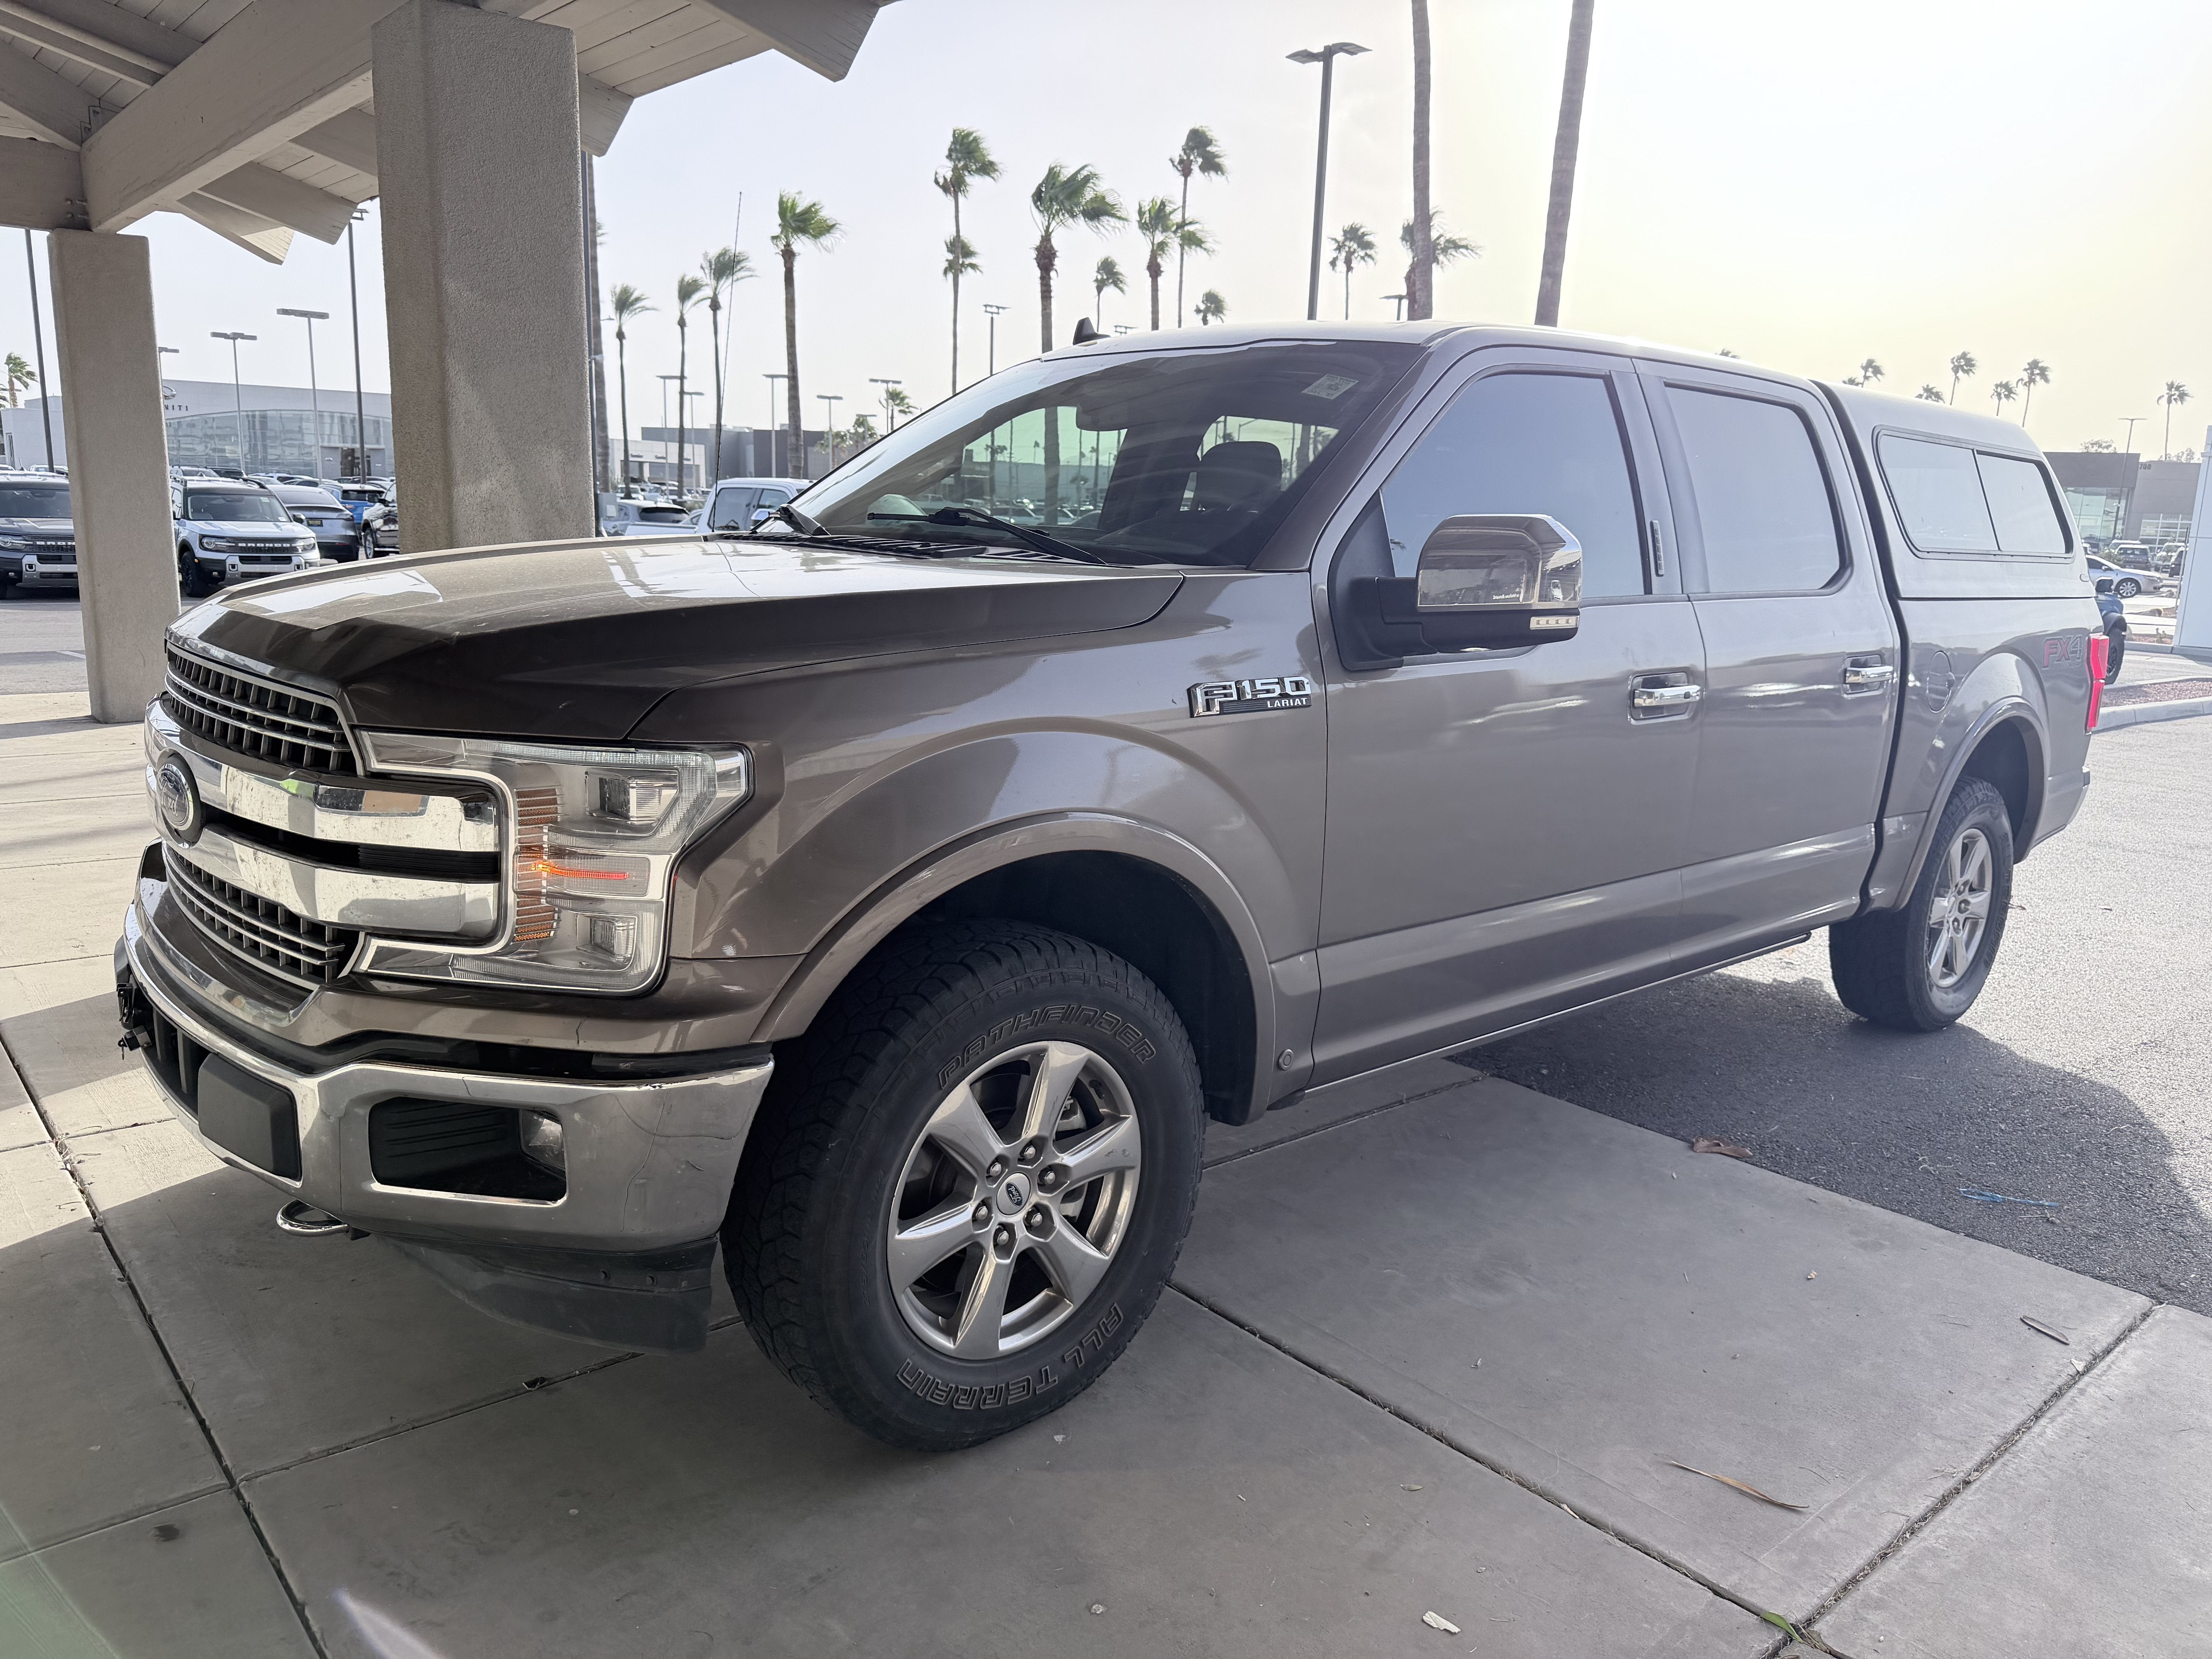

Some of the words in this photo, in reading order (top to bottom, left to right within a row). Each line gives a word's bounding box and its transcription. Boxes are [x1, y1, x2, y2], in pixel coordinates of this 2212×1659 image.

[2042, 634, 2083, 670] FX4
[1267, 697, 1308, 708] LARIAT
[159, 773, 179, 817] Ford
[938, 1004, 1156, 1090] PATHFINDER
[1008, 1185, 1021, 1203] Ford
[1062, 1302, 1123, 1368] ALL
[896, 1357, 1058, 1410] TERRAIN
